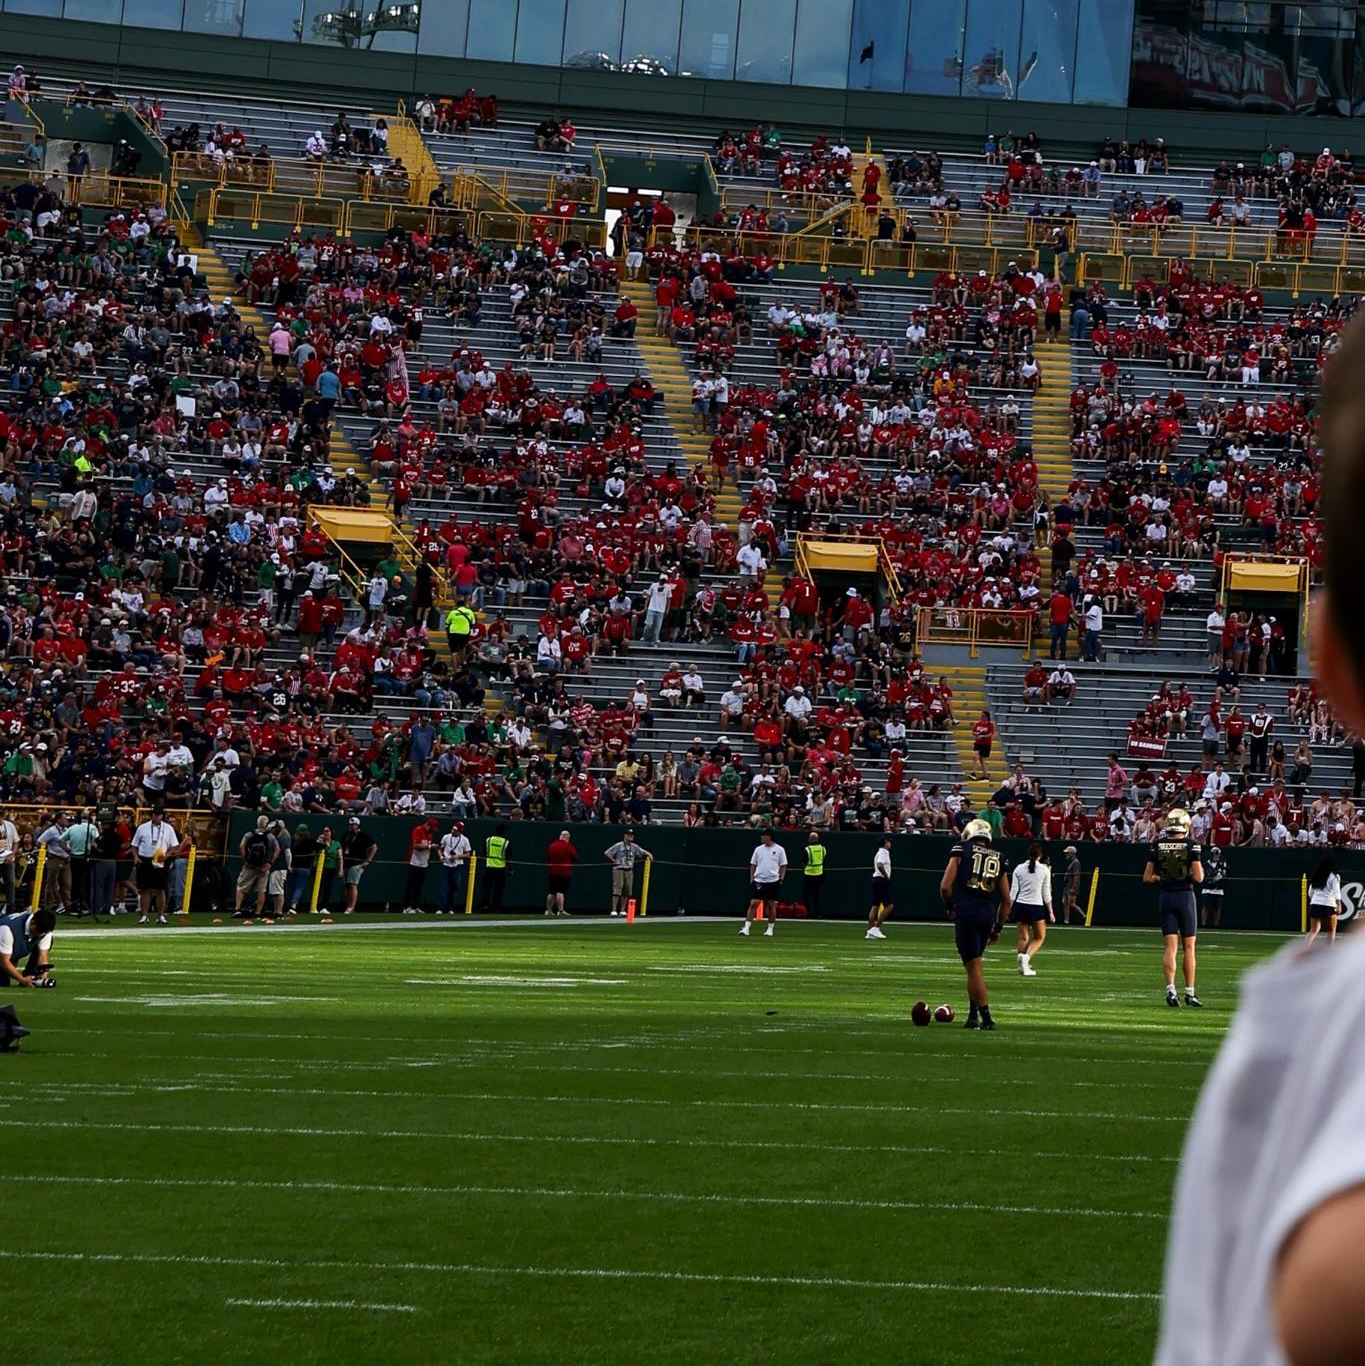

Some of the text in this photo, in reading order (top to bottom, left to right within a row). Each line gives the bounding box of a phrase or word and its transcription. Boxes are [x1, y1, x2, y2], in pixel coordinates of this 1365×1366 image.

[272, 692, 287, 706] 26
[1164, 779, 1176, 793] 23
[966, 852, 1001, 891] 18
